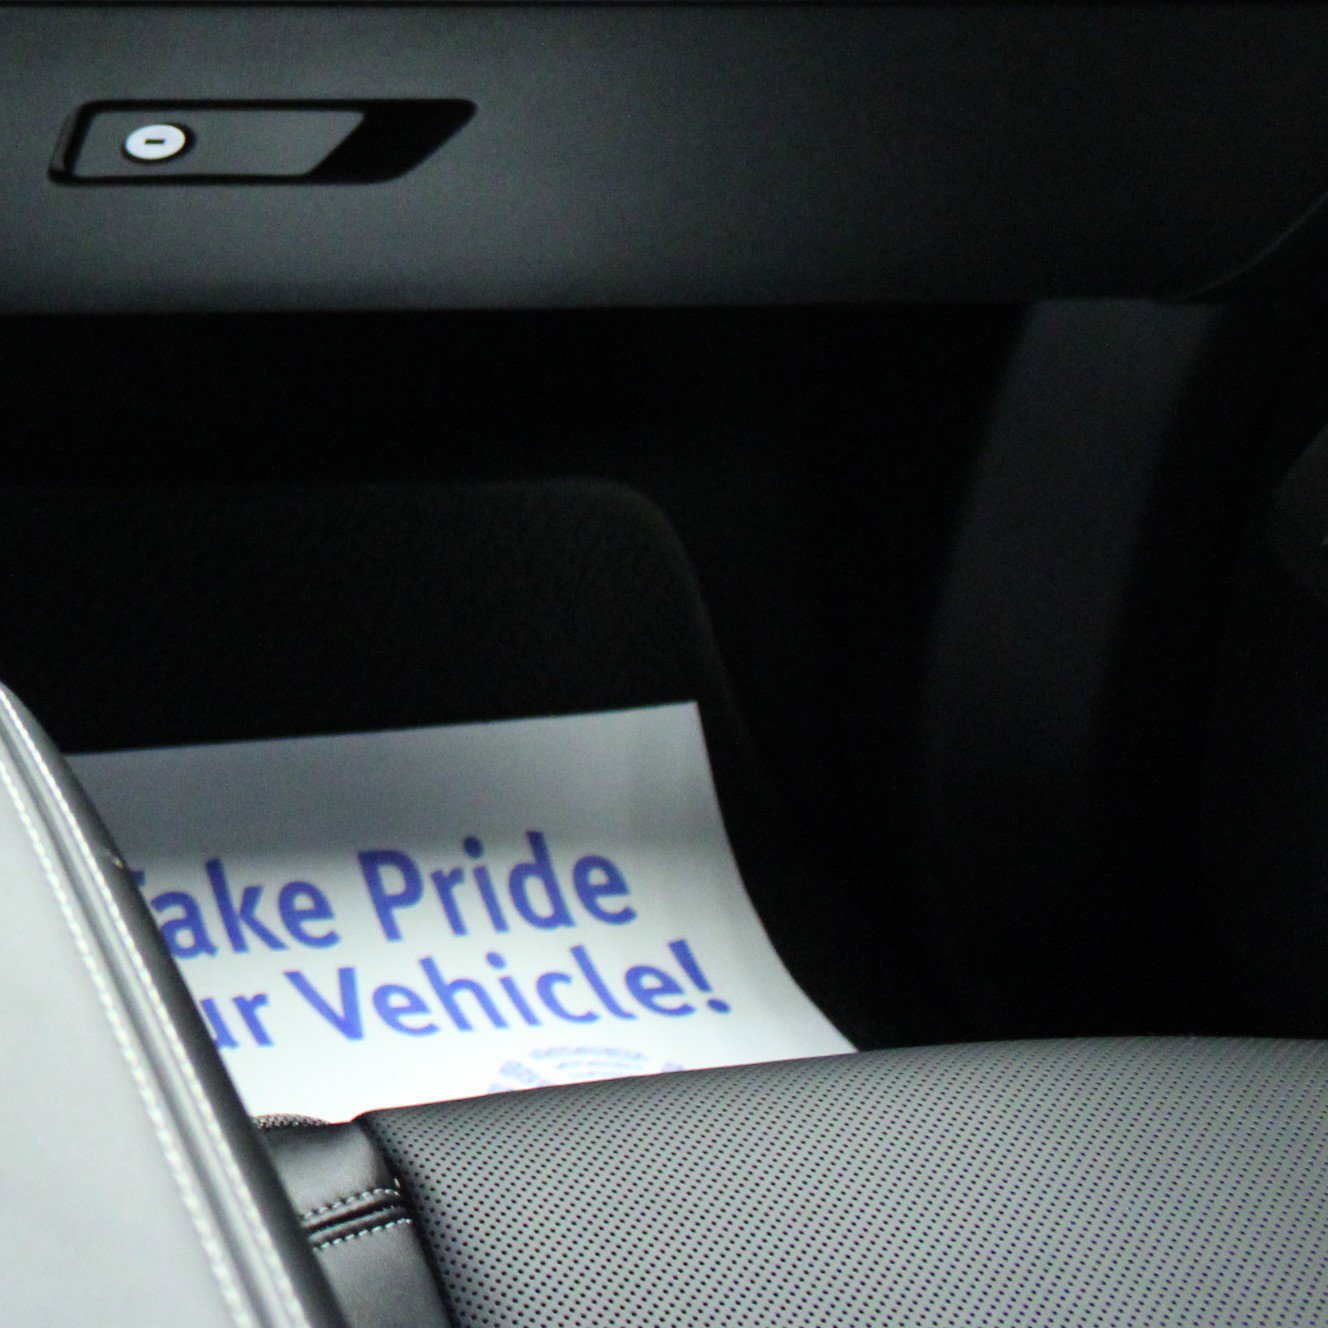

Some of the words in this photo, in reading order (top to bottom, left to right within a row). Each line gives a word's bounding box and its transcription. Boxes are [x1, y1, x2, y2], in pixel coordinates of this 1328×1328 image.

[132, 860, 343, 961] ake
[359, 832, 639, 944] Pride
[284, 939, 733, 1043] Vehicle!
